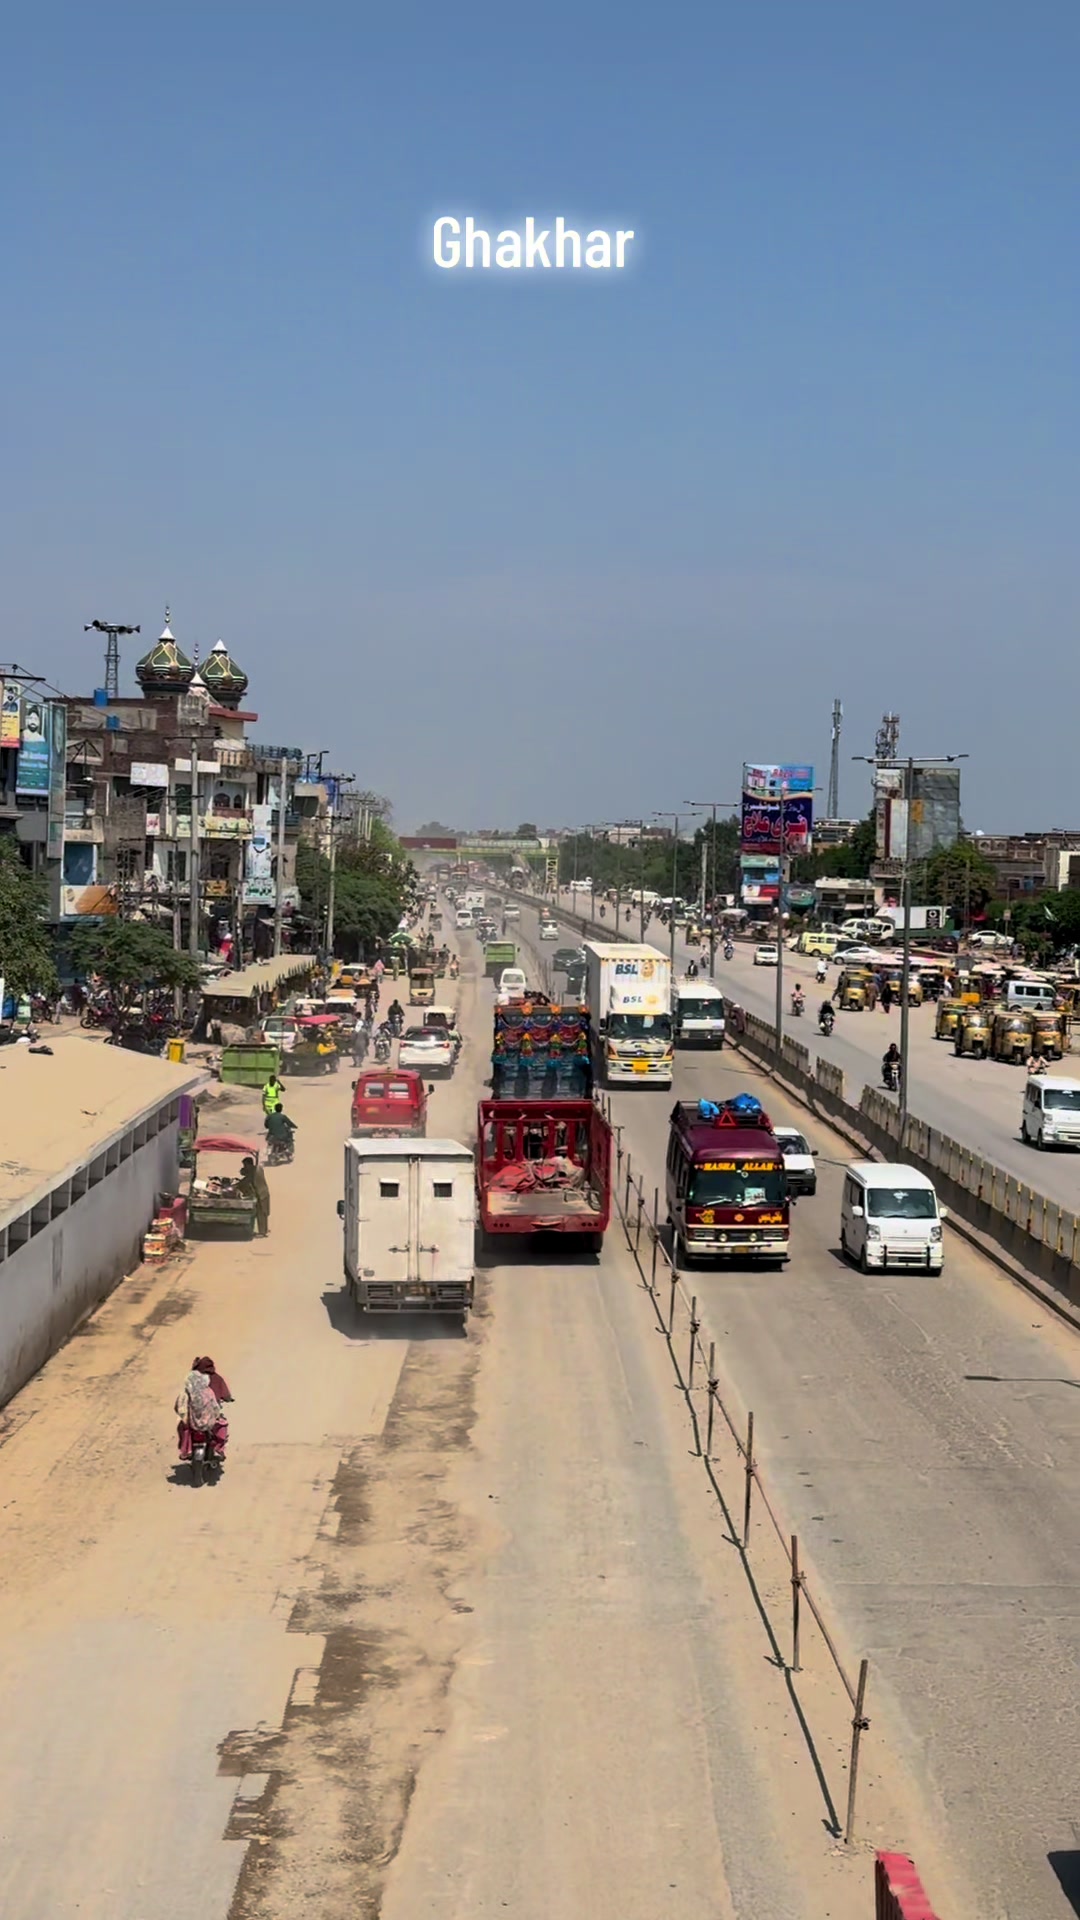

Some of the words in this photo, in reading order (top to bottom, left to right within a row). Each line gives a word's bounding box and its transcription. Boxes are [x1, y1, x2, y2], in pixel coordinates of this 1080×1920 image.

[615, 964, 638, 975] BSL
[623, 996, 643, 1004] BSL
[742, 1162, 774, 1171] ALLAH
